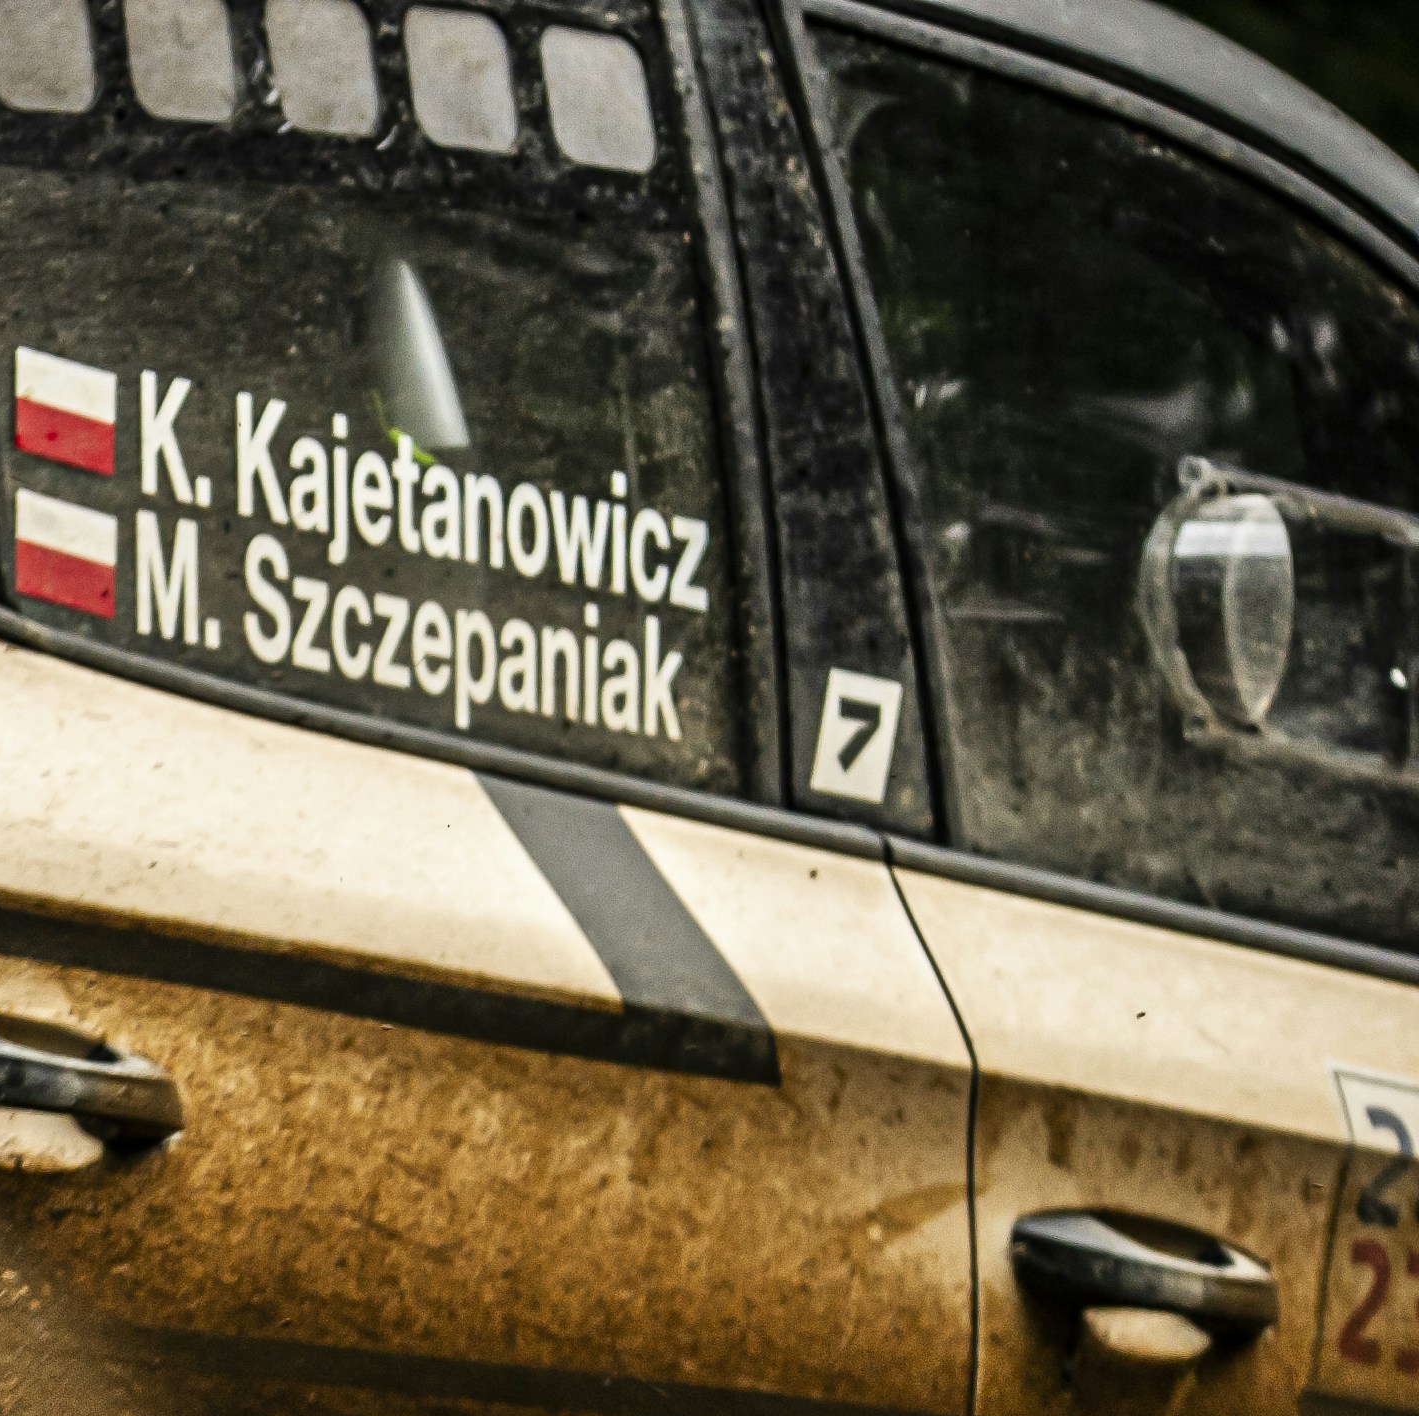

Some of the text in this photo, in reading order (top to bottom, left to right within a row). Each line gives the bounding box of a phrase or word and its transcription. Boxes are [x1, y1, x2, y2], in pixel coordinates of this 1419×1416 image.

[139, 368, 711, 613] K. Kajetanowicz
[134, 508, 684, 741] M. Szczepaniak
[836, 695, 882, 774] 7
